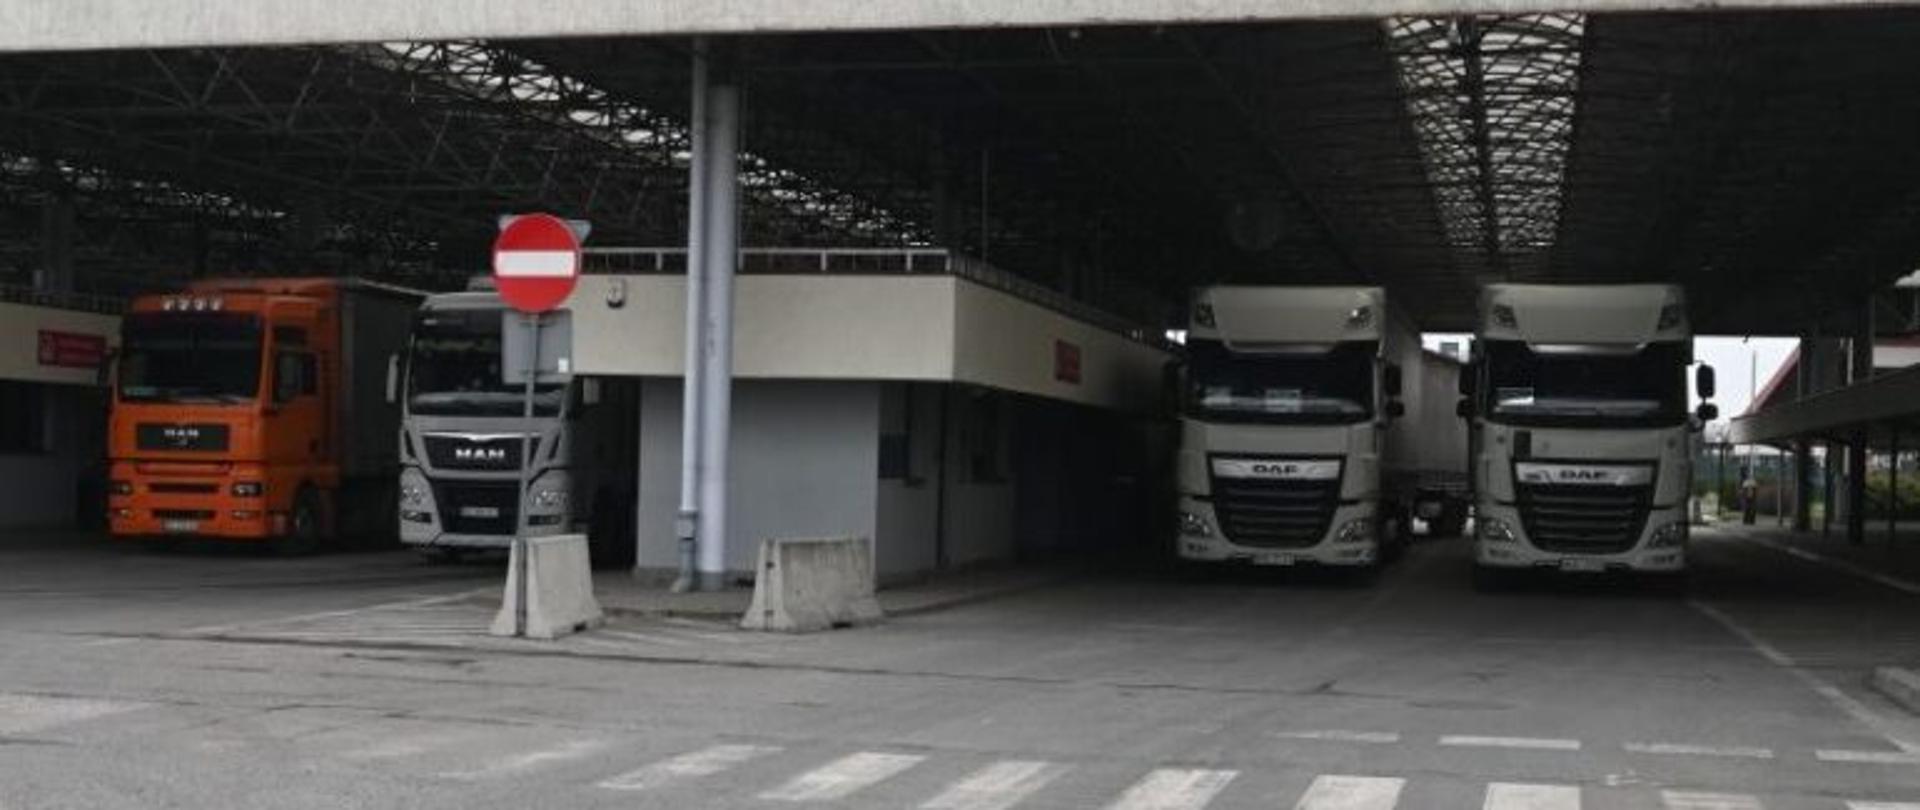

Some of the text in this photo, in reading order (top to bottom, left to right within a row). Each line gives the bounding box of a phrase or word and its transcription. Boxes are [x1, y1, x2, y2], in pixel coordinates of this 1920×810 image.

[455, 448, 505, 459] MAN
[1253, 464, 1299, 474] DAF
[1560, 470, 1607, 480] DAF
